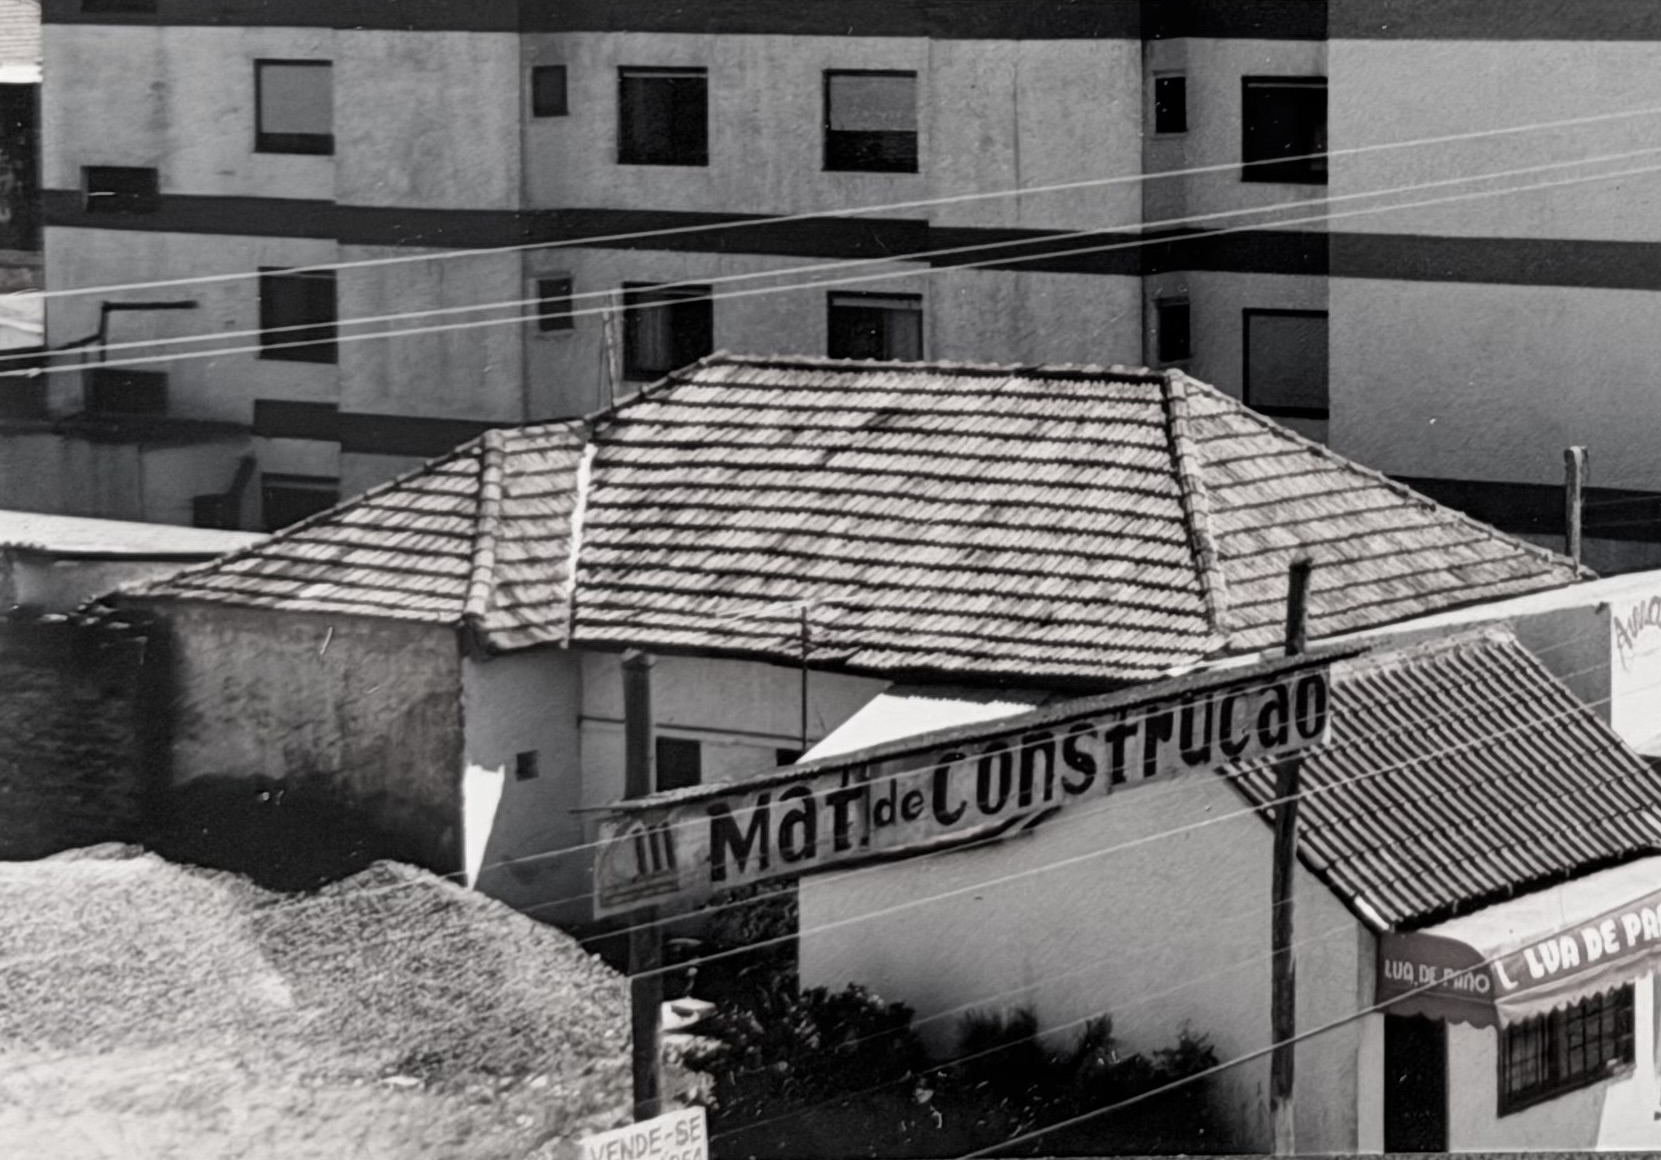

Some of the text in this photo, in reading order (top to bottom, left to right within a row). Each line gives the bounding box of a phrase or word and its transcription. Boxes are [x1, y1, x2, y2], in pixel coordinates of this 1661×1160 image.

[873, 778, 925, 828] de
[1523, 936, 1580, 979] LUA
[1581, 919, 1620, 962] DE
[1419, 963, 1438, 986] DE
[590, 1115, 701, 1160] VENDE-SE
